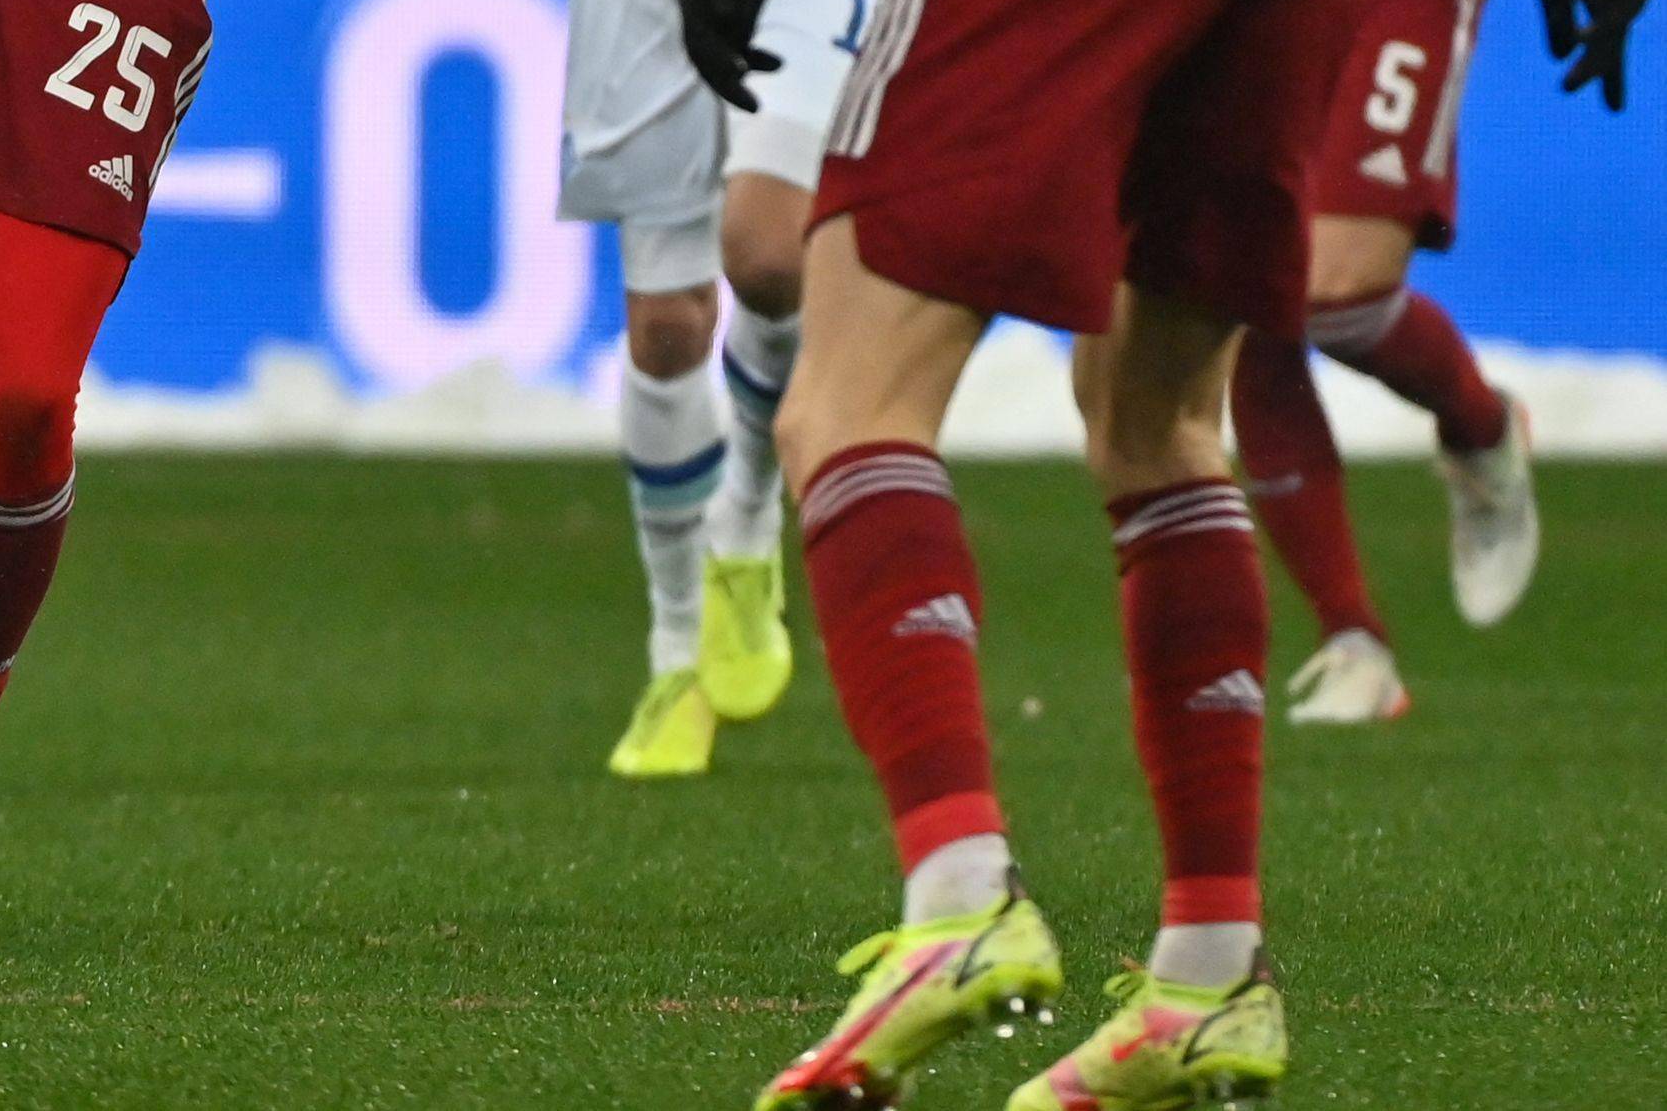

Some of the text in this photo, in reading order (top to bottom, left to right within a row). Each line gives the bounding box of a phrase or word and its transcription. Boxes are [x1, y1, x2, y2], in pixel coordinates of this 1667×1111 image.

[44, 2, 172, 132] 25
[1364, 40, 1427, 133] 5
[88, 164, 133, 202] adidas
